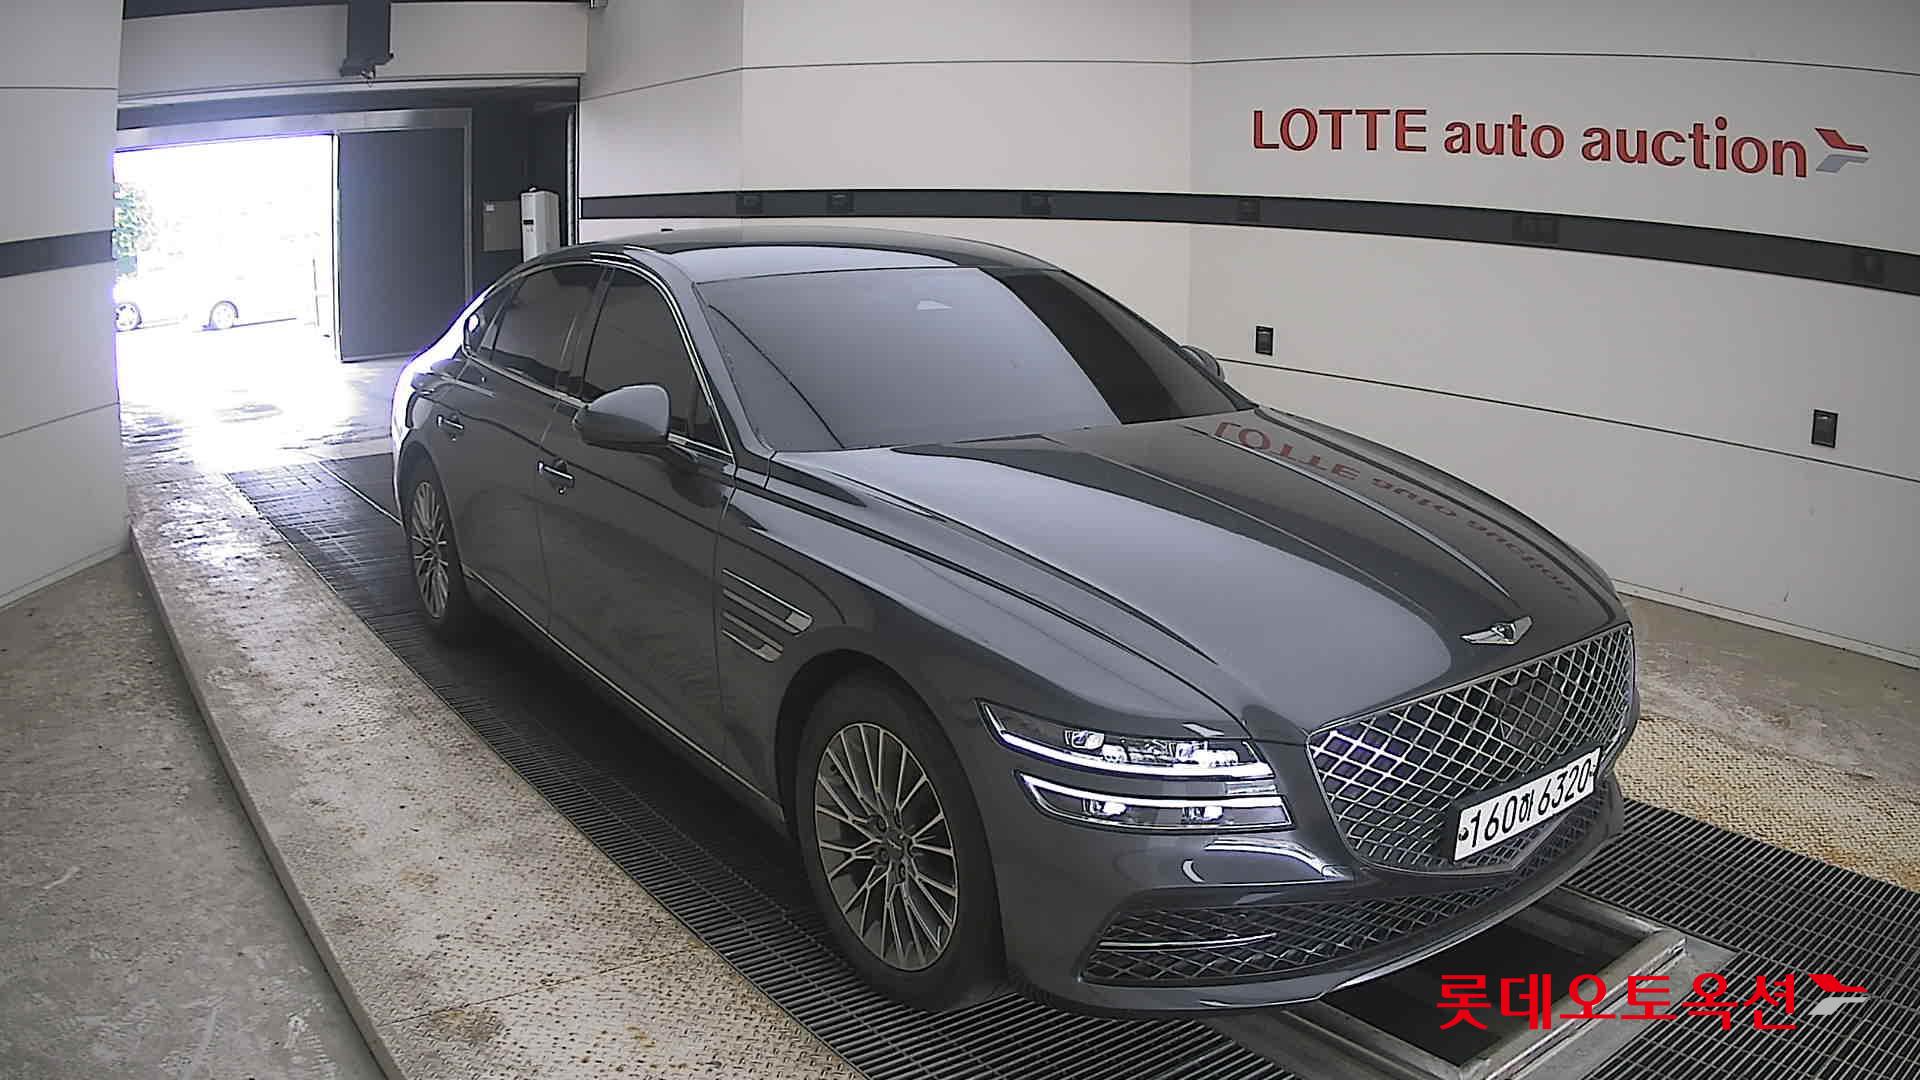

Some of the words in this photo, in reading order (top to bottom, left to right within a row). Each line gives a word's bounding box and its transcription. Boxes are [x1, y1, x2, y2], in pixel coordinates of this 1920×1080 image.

[1252, 108, 1427, 152] LOTTE
[1443, 114, 1565, 159] auto
[1581, 116, 1808, 178] auction
[1470, 788, 1535, 848] 160하
[1537, 757, 1592, 816] 6320
